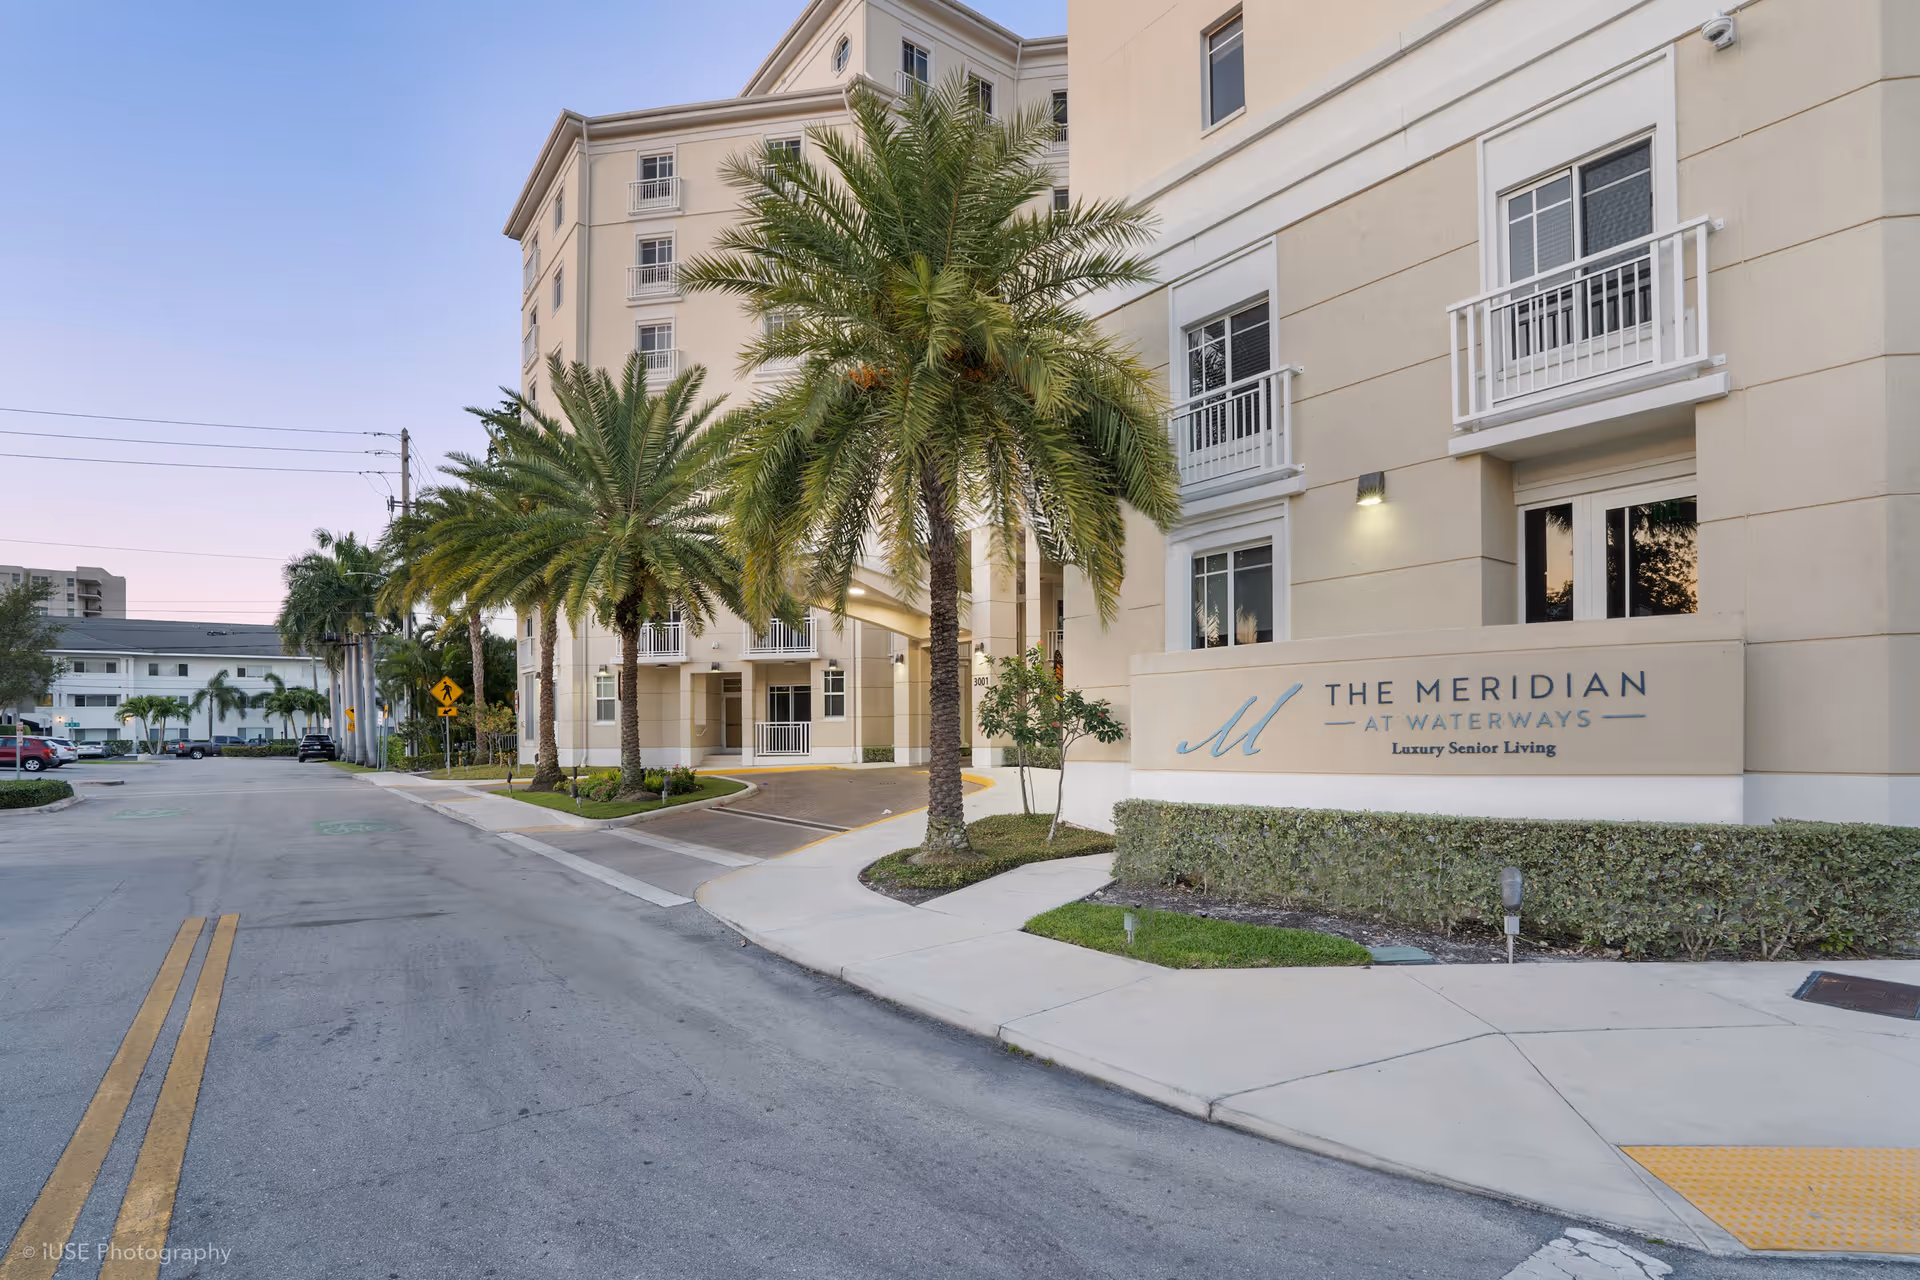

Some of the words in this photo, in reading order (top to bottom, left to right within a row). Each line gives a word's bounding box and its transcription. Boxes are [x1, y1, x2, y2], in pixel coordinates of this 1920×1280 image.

[974, 677, 989, 686] 3001
[1325, 681, 1394, 706] THE
[1416, 670, 1646, 703] MERIDIAN
[1364, 715, 1394, 732] AT
[1406, 709, 1592, 731] WATERWAYS
[1391, 742, 1446, 758] Luxury
[1448, 741, 1499, 755] Senior
[1503, 740, 1557, 758] Living
